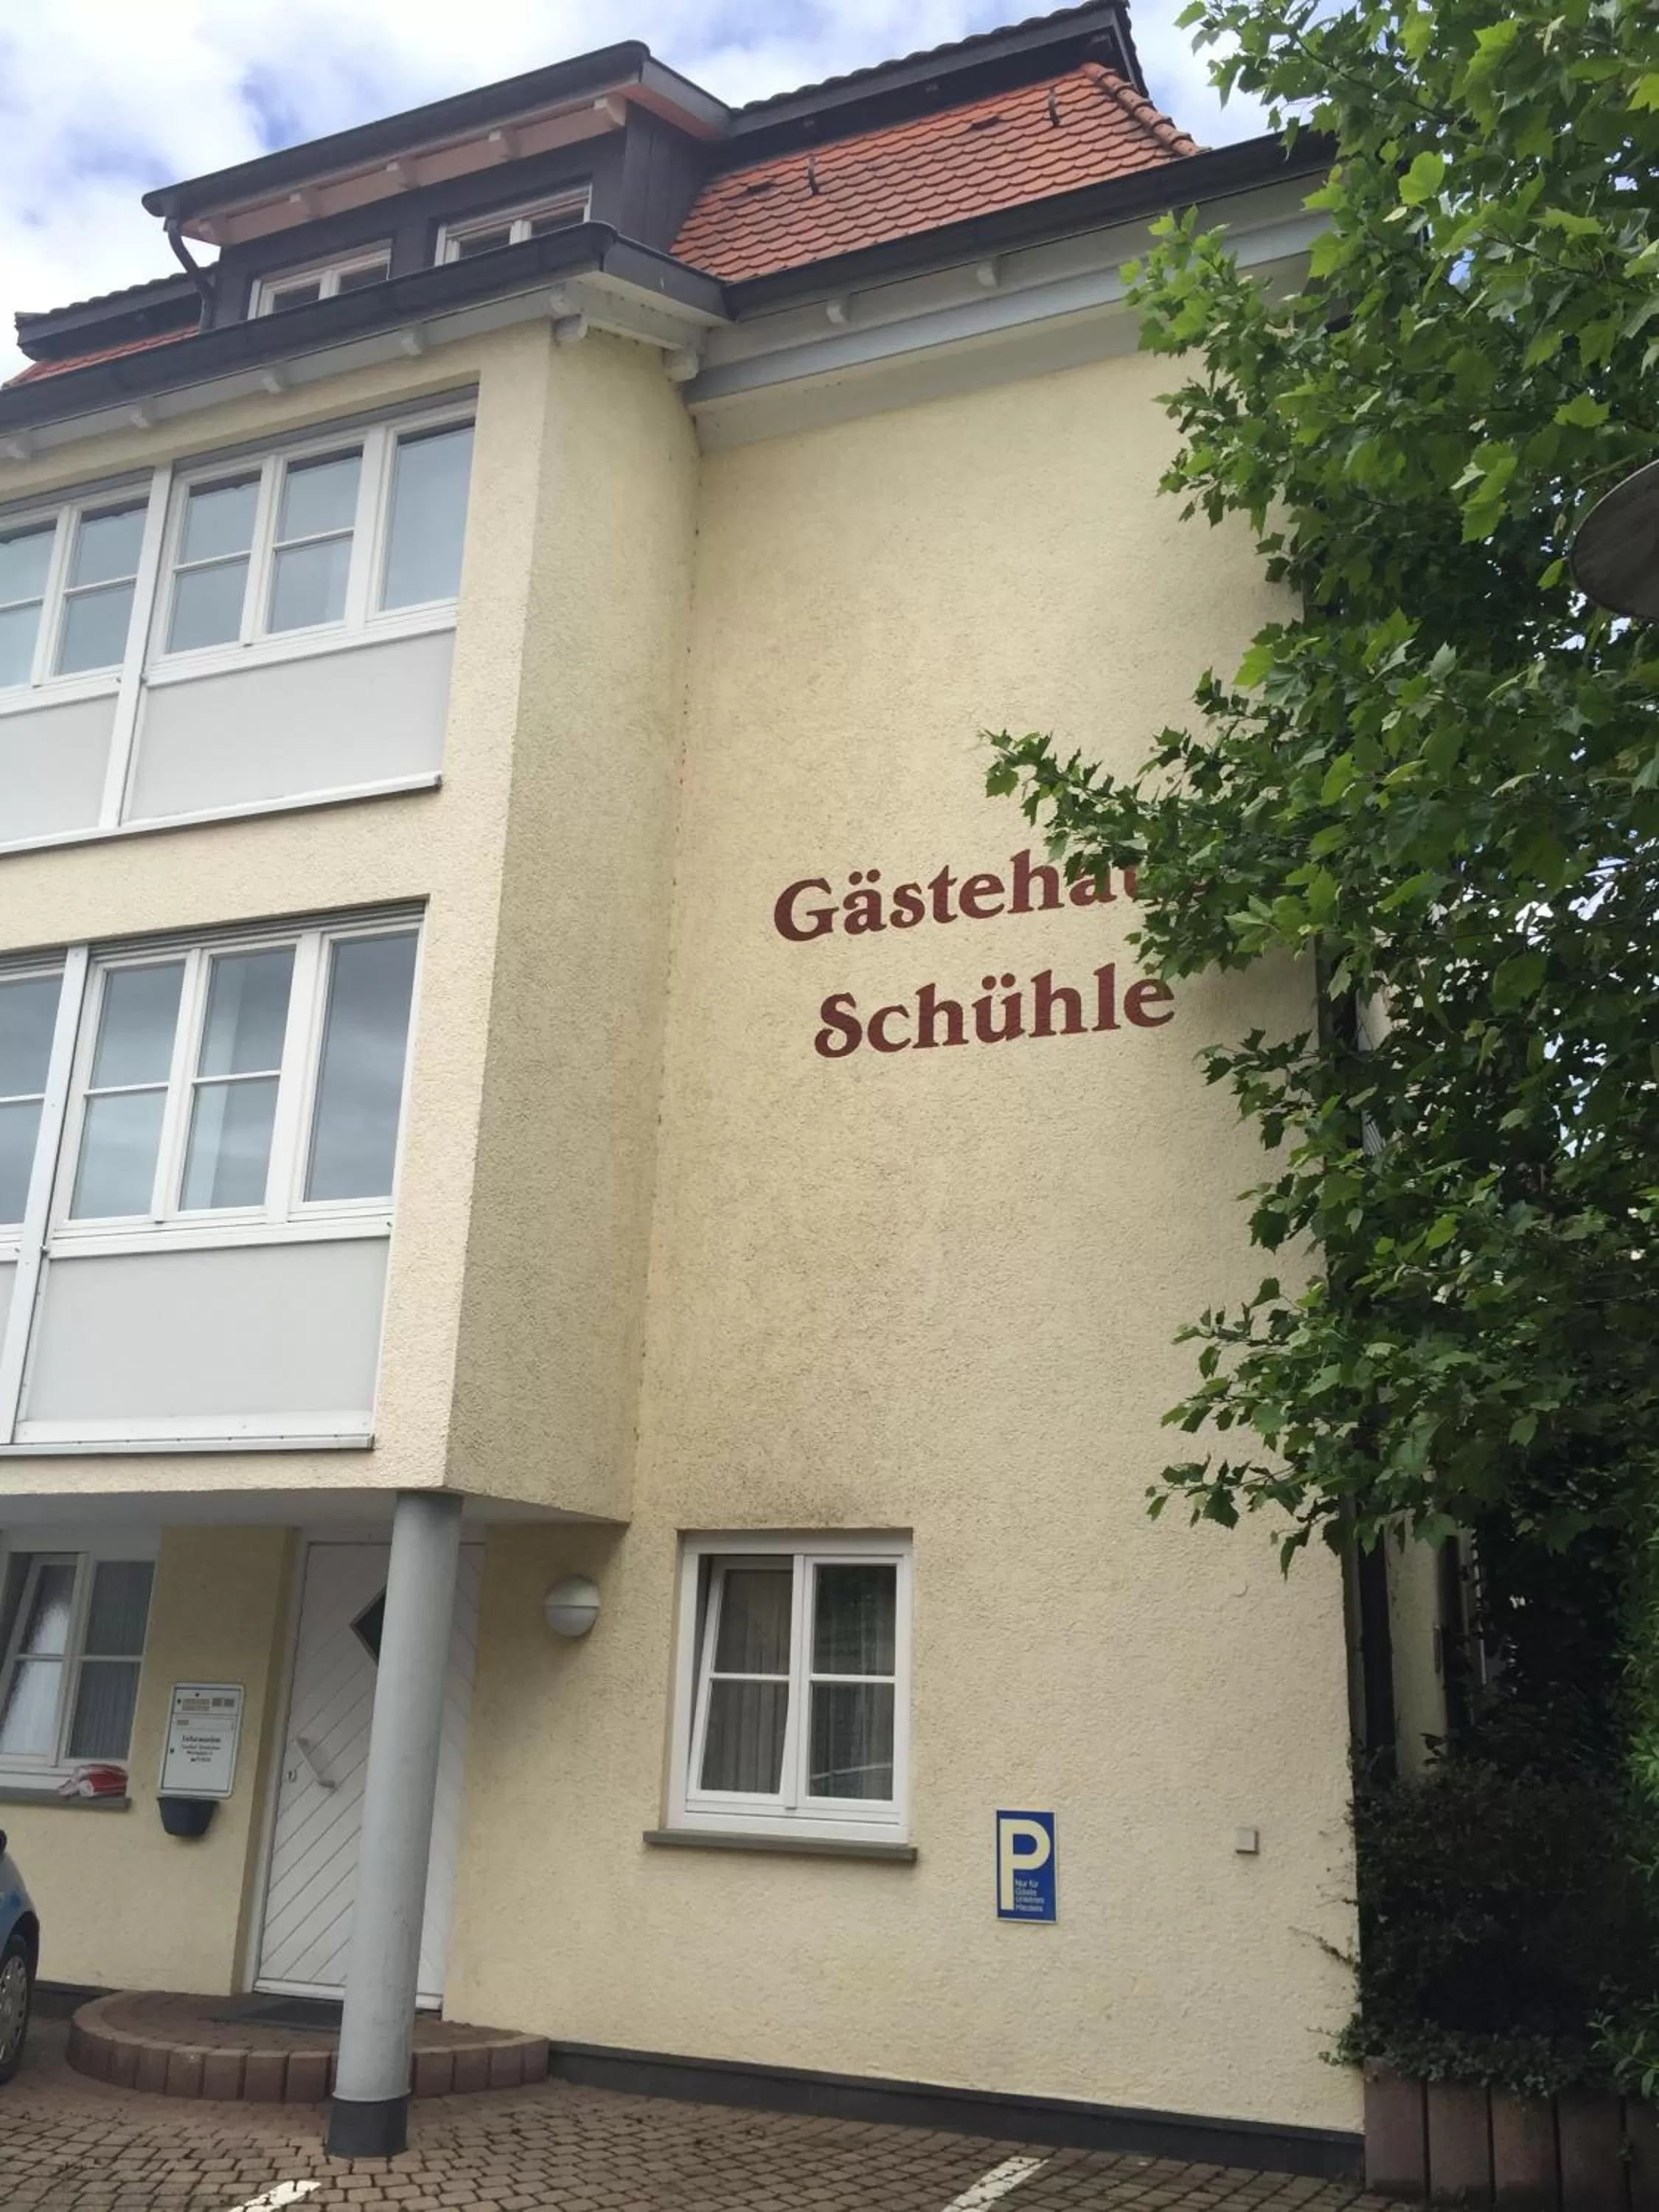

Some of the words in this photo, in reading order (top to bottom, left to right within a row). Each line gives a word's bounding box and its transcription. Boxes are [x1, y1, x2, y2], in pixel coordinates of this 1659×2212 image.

[773, 849, 1209, 942] Gästeha
[814, 962, 1175, 1058] Schühle
[1000, 1818, 1051, 1911] P
